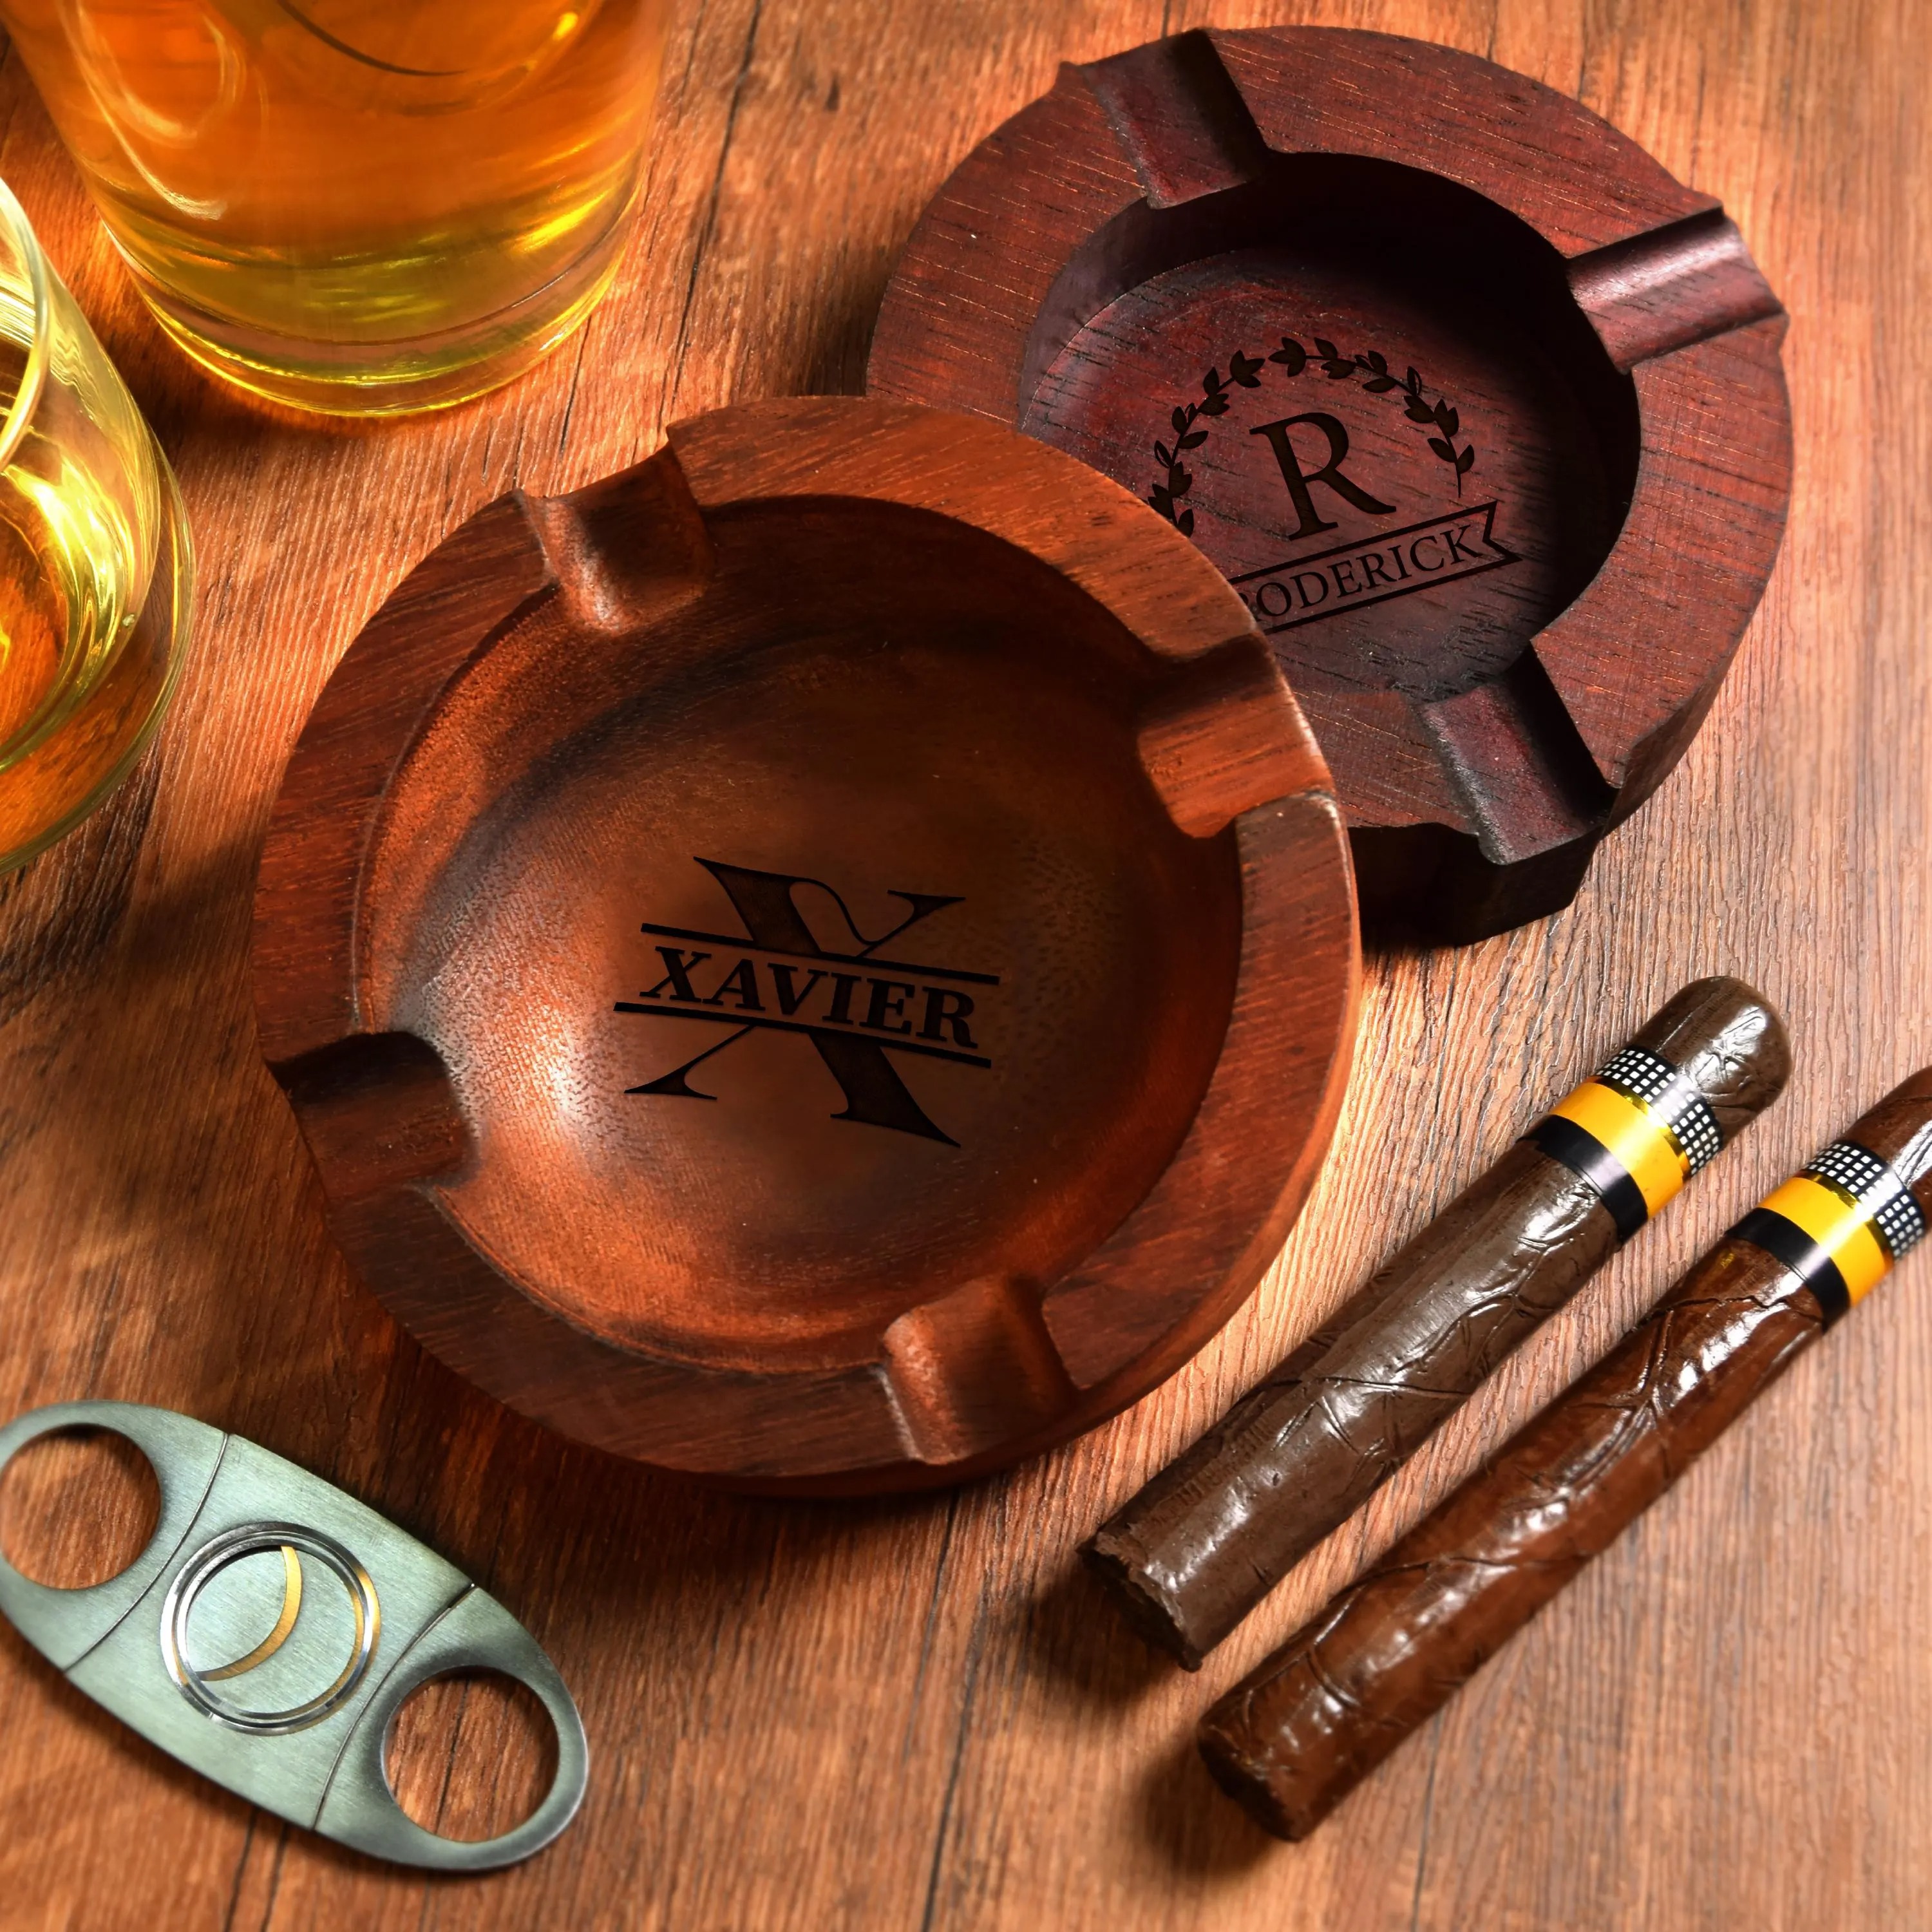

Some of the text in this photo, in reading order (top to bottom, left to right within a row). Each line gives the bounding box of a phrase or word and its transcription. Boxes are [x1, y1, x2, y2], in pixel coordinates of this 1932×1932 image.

[1249, 412, 1397, 540] R
[623, 857, 966, 1148] X
[639, 945, 978, 1048] XAVIER
